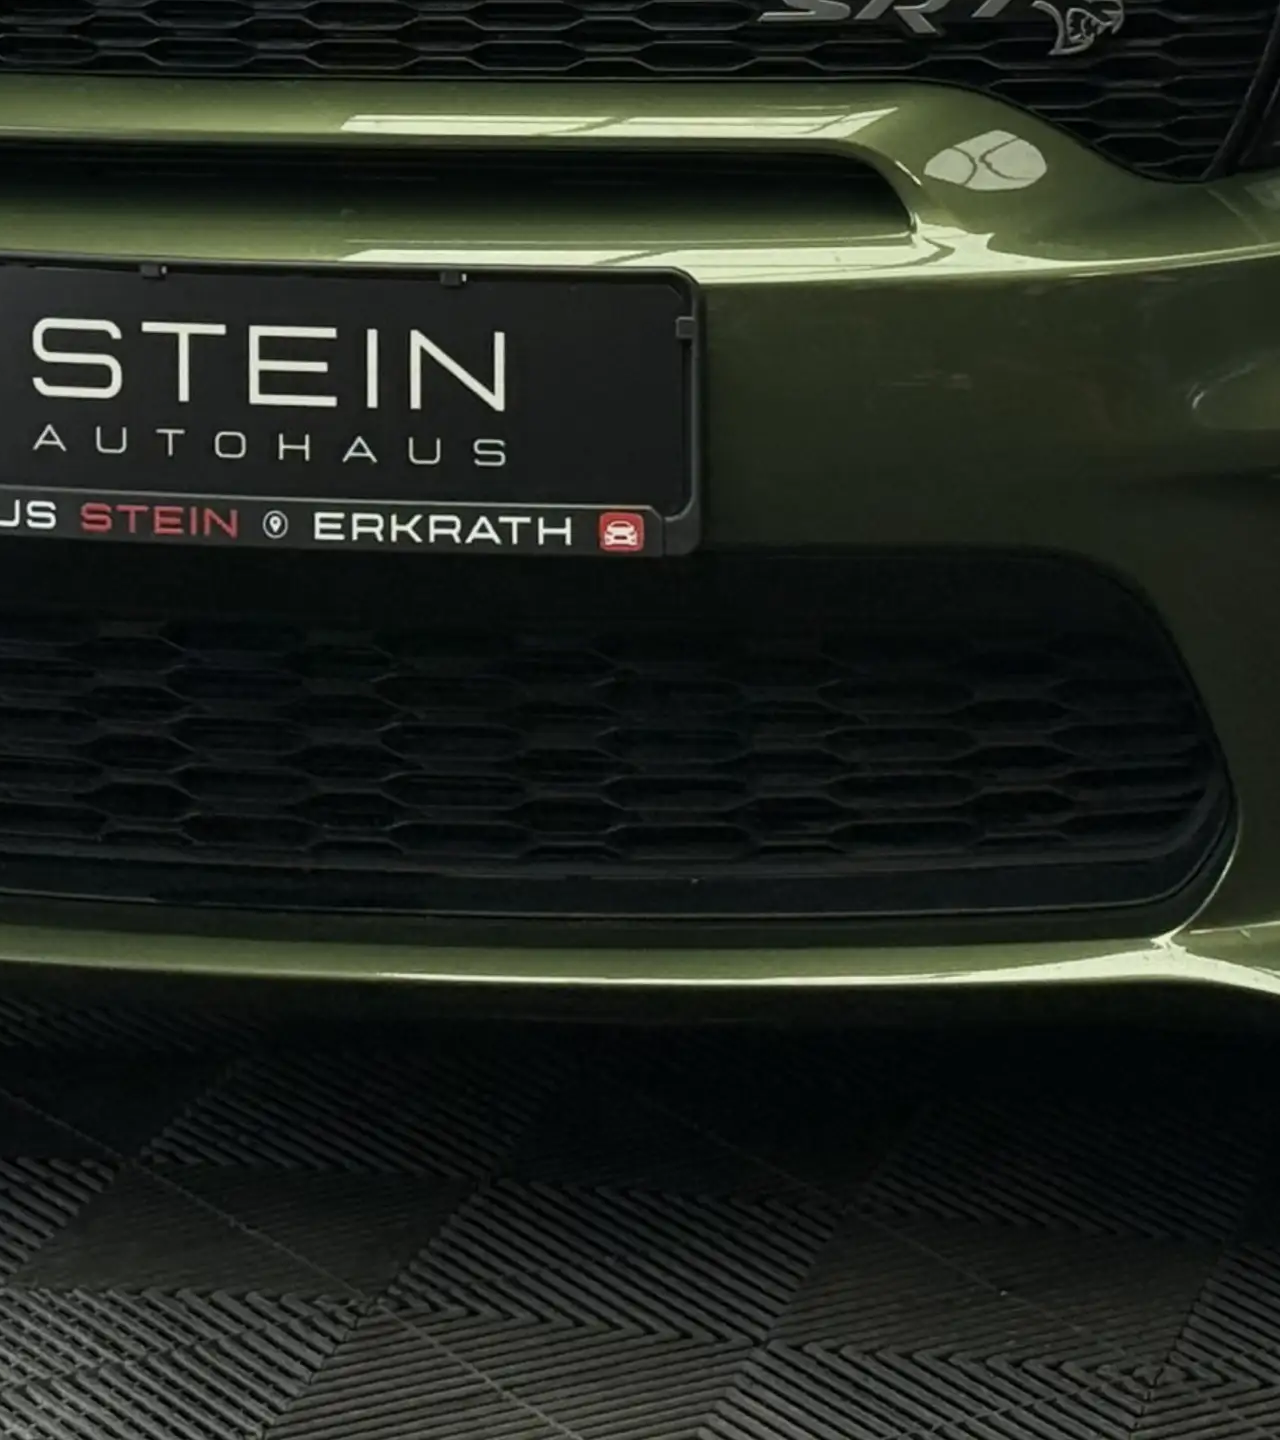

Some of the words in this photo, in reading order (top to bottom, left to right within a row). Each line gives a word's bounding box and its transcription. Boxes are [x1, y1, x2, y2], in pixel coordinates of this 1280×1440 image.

[32, 317, 506, 412] STEIN
[32, 423, 506, 467] AUTOHAUS
[81, 502, 239, 538] STEIN
[313, 510, 572, 546] ERKRATH
